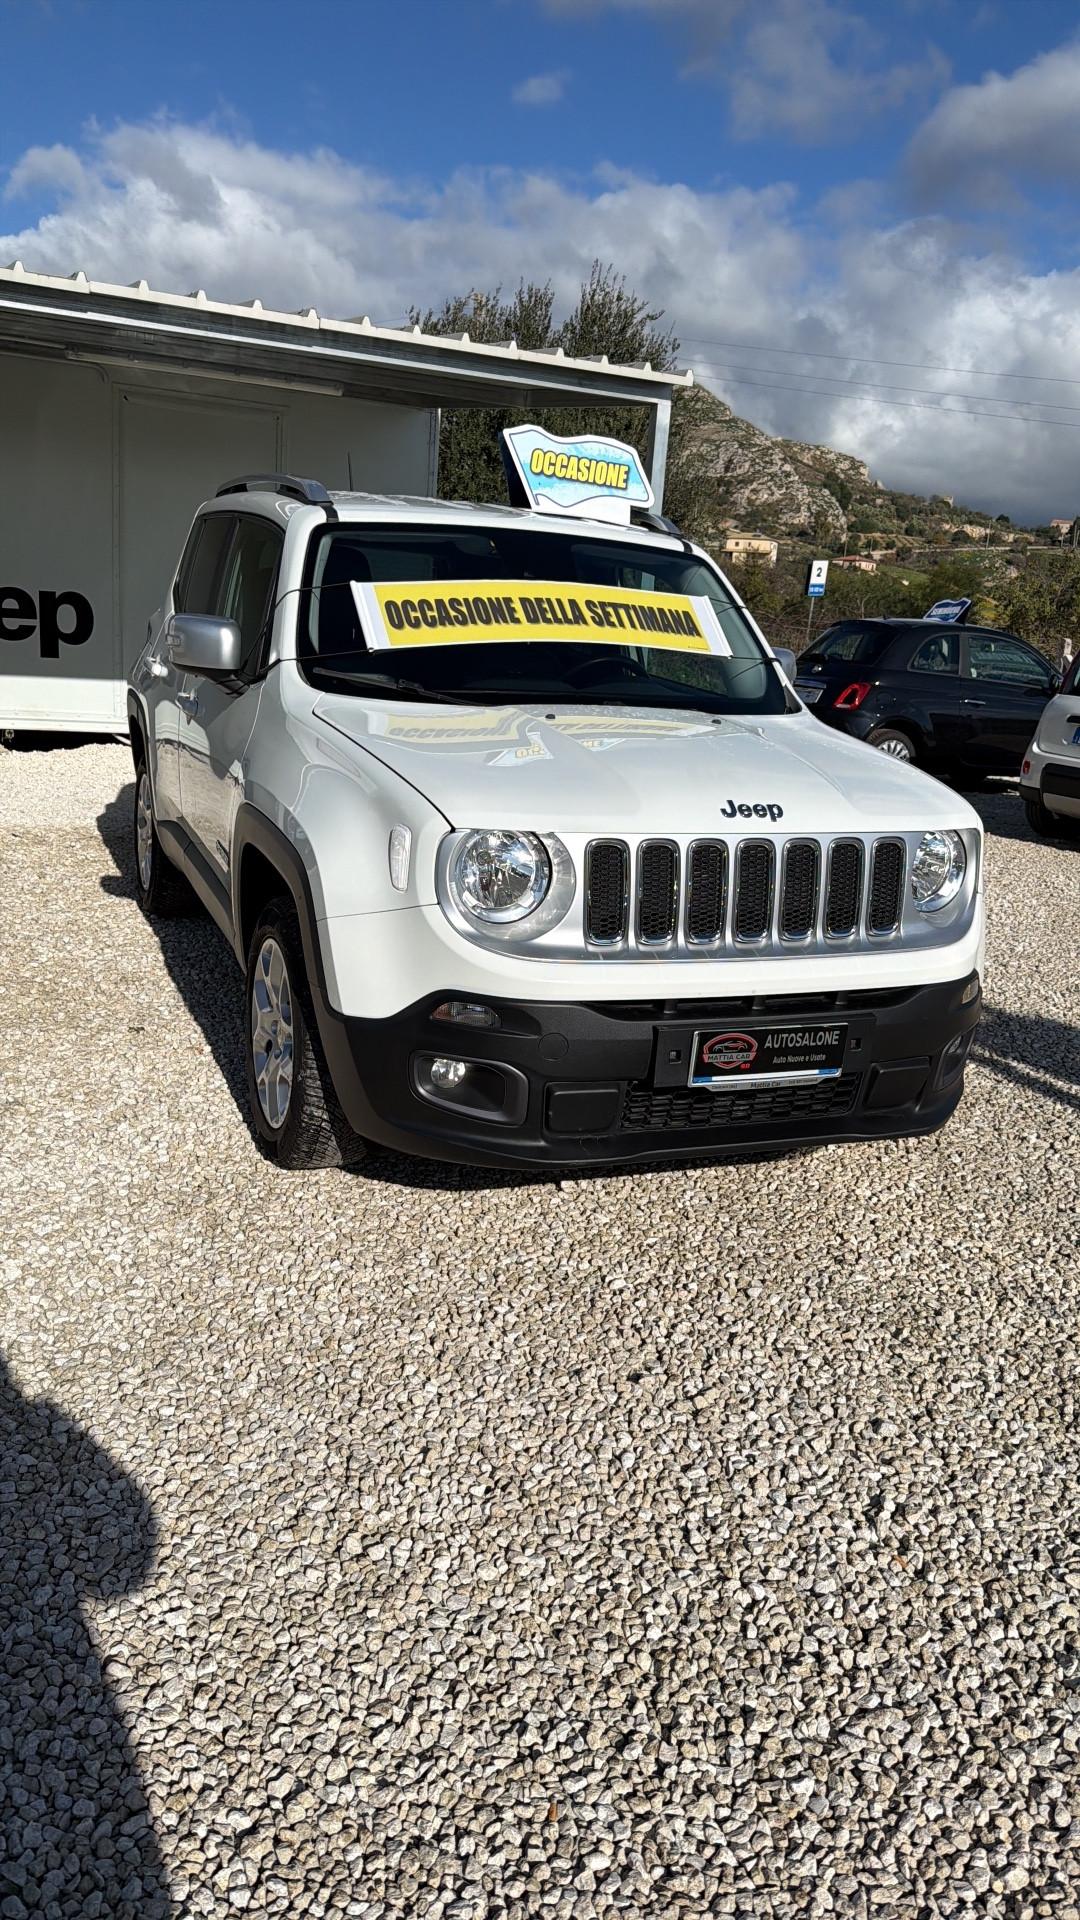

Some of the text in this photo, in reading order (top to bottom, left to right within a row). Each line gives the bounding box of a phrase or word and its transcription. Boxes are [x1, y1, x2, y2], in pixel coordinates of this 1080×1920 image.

[530, 448, 629, 489] OCCASIONE
[816, 567, 822, 577] 2
[0, 587, 94, 658] ep
[384, 597, 702, 638] OCCASIONE DELLA SETTIMANA
[720, 800, 783, 822] Jeep
[764, 1031, 840, 1049] AUTOSALONE
[772, 1056, 787, 1064] Auto
[787, 1055, 804, 1063] Nuove
[810, 1053, 827, 1062] Usate
[750, 1081, 770, 1089] Mattia
